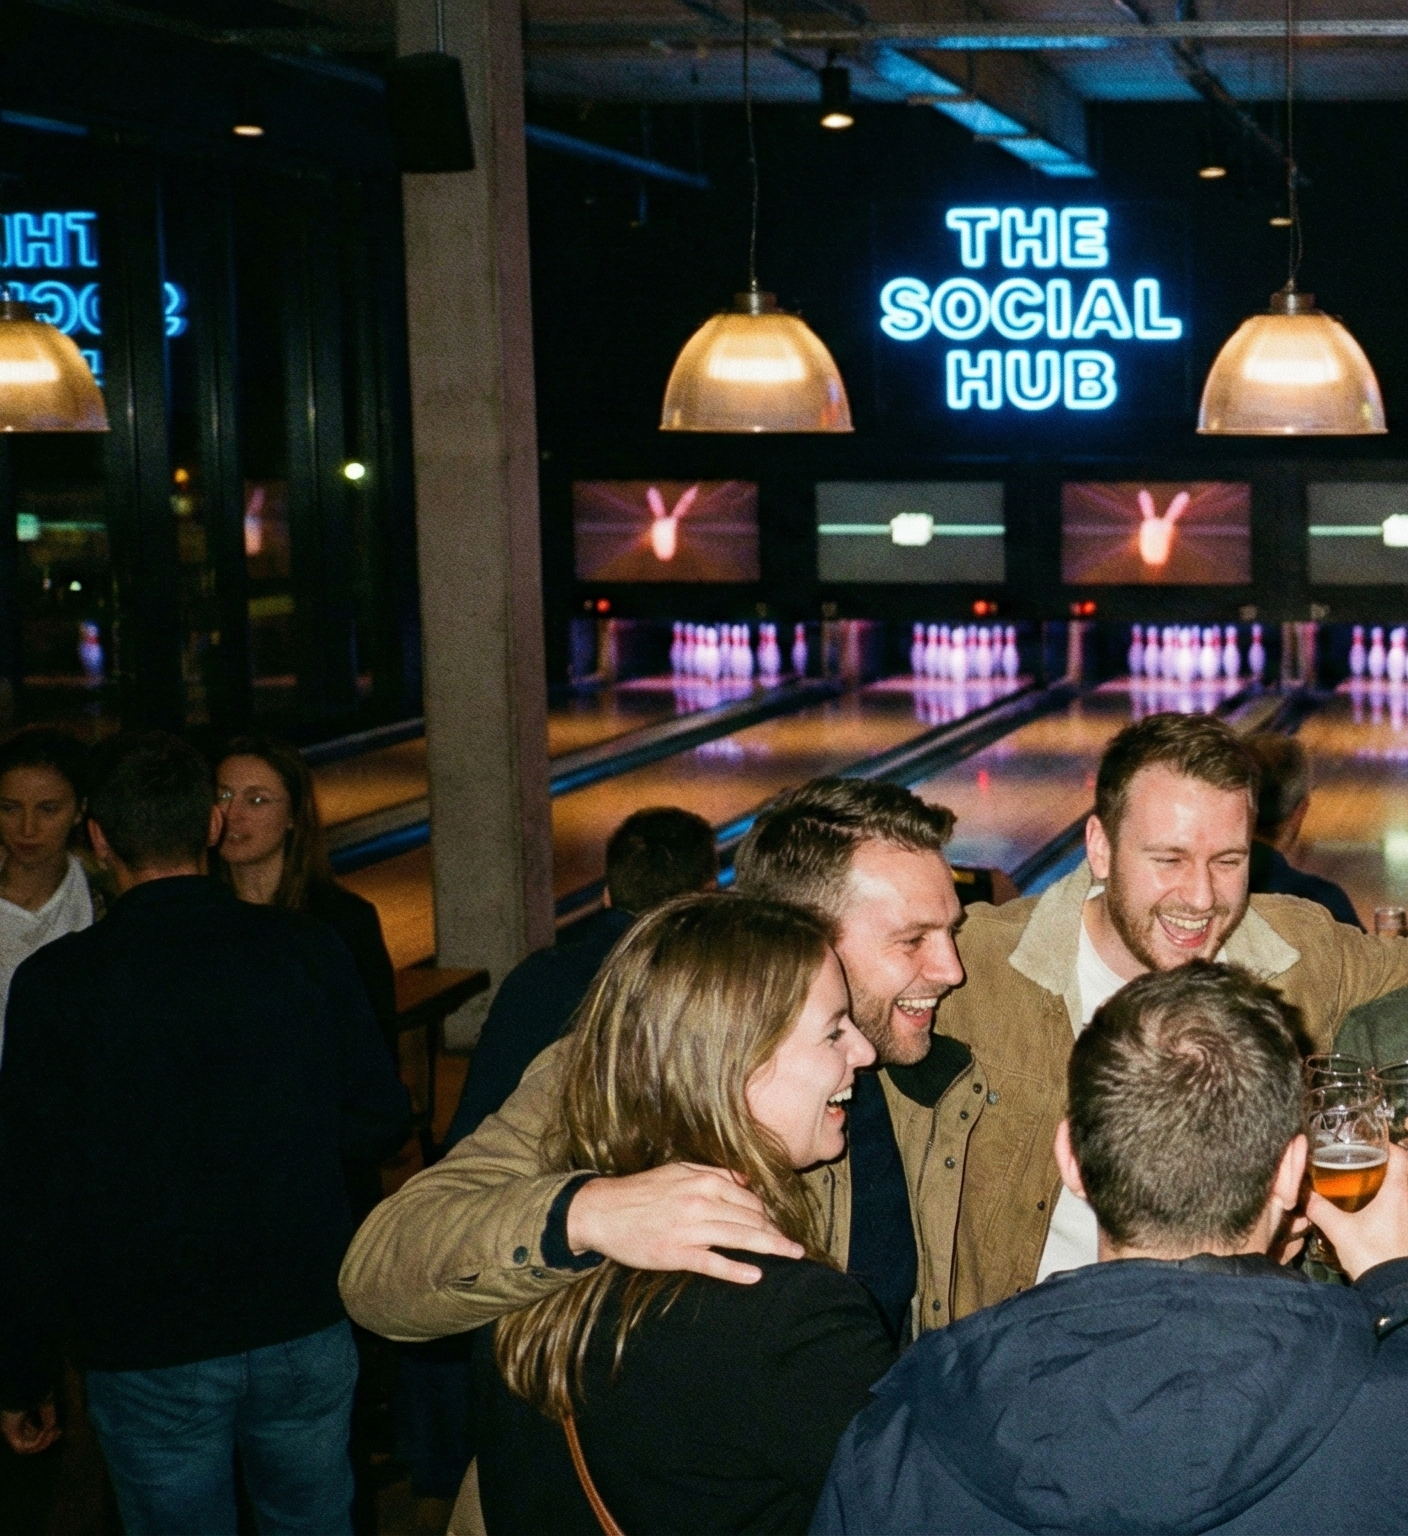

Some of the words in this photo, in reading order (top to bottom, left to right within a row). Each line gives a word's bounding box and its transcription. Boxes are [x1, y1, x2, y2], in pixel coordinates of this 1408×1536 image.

[946, 207, 1109, 268] THE
[880, 277, 1183, 341] SOCIAL
[945, 350, 1118, 411] HUB
